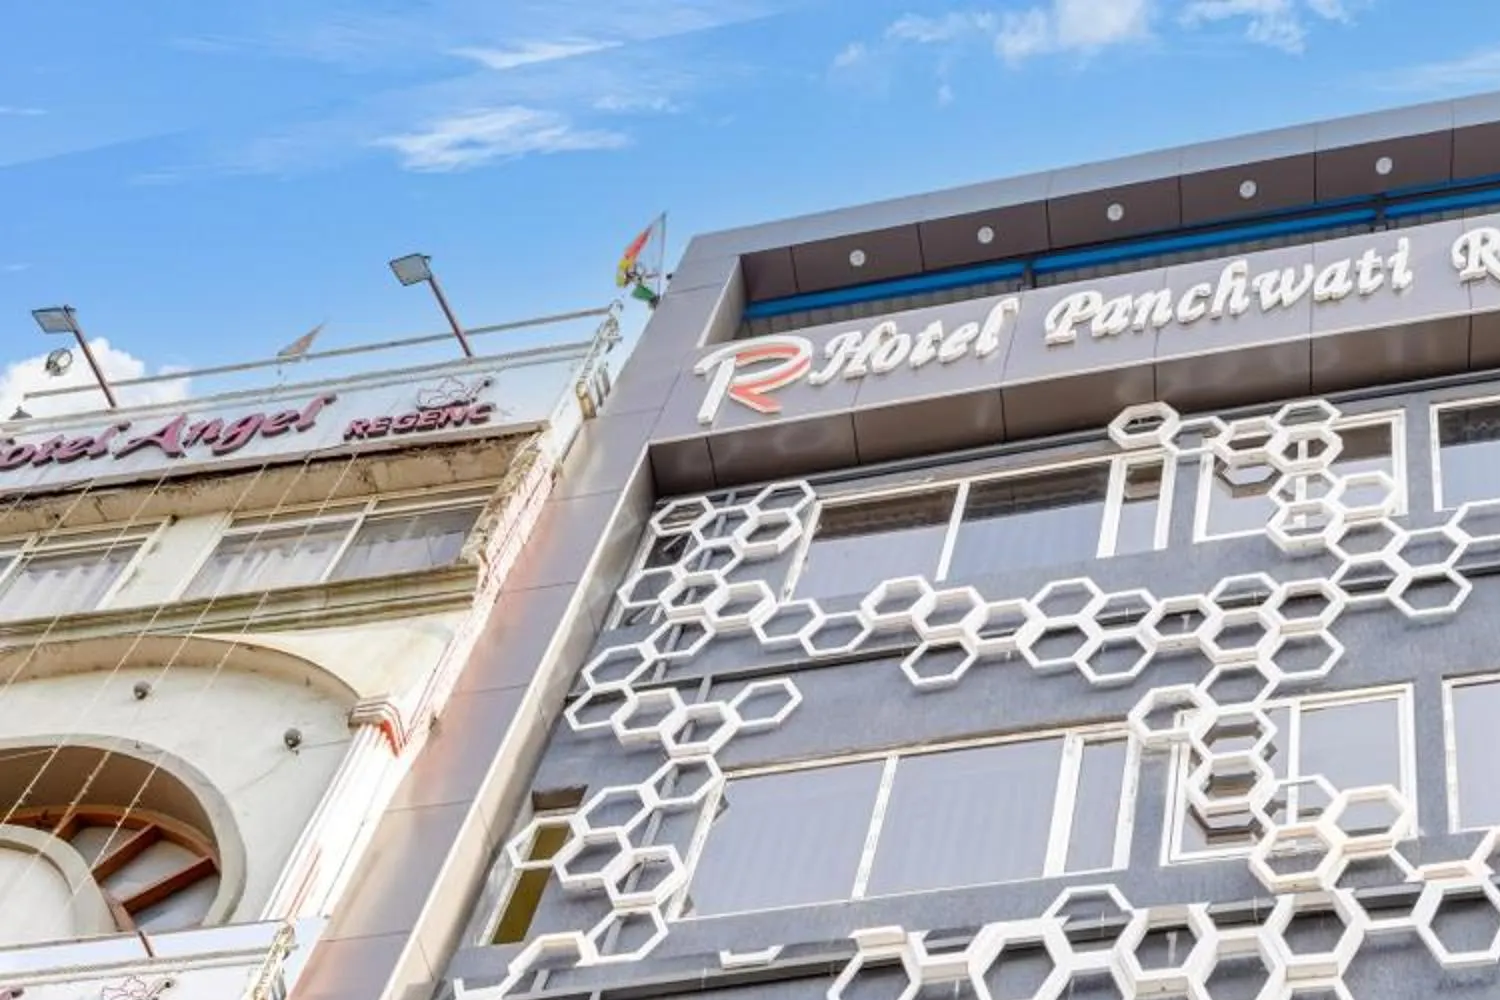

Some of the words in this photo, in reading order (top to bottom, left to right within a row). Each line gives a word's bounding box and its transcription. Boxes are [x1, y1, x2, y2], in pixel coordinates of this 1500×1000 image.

[808, 297, 1021, 385] Hotel
[1044, 236, 1413, 346] Panchwati
[0, 420, 132, 470] otel
[112, 392, 337, 460] Angel
